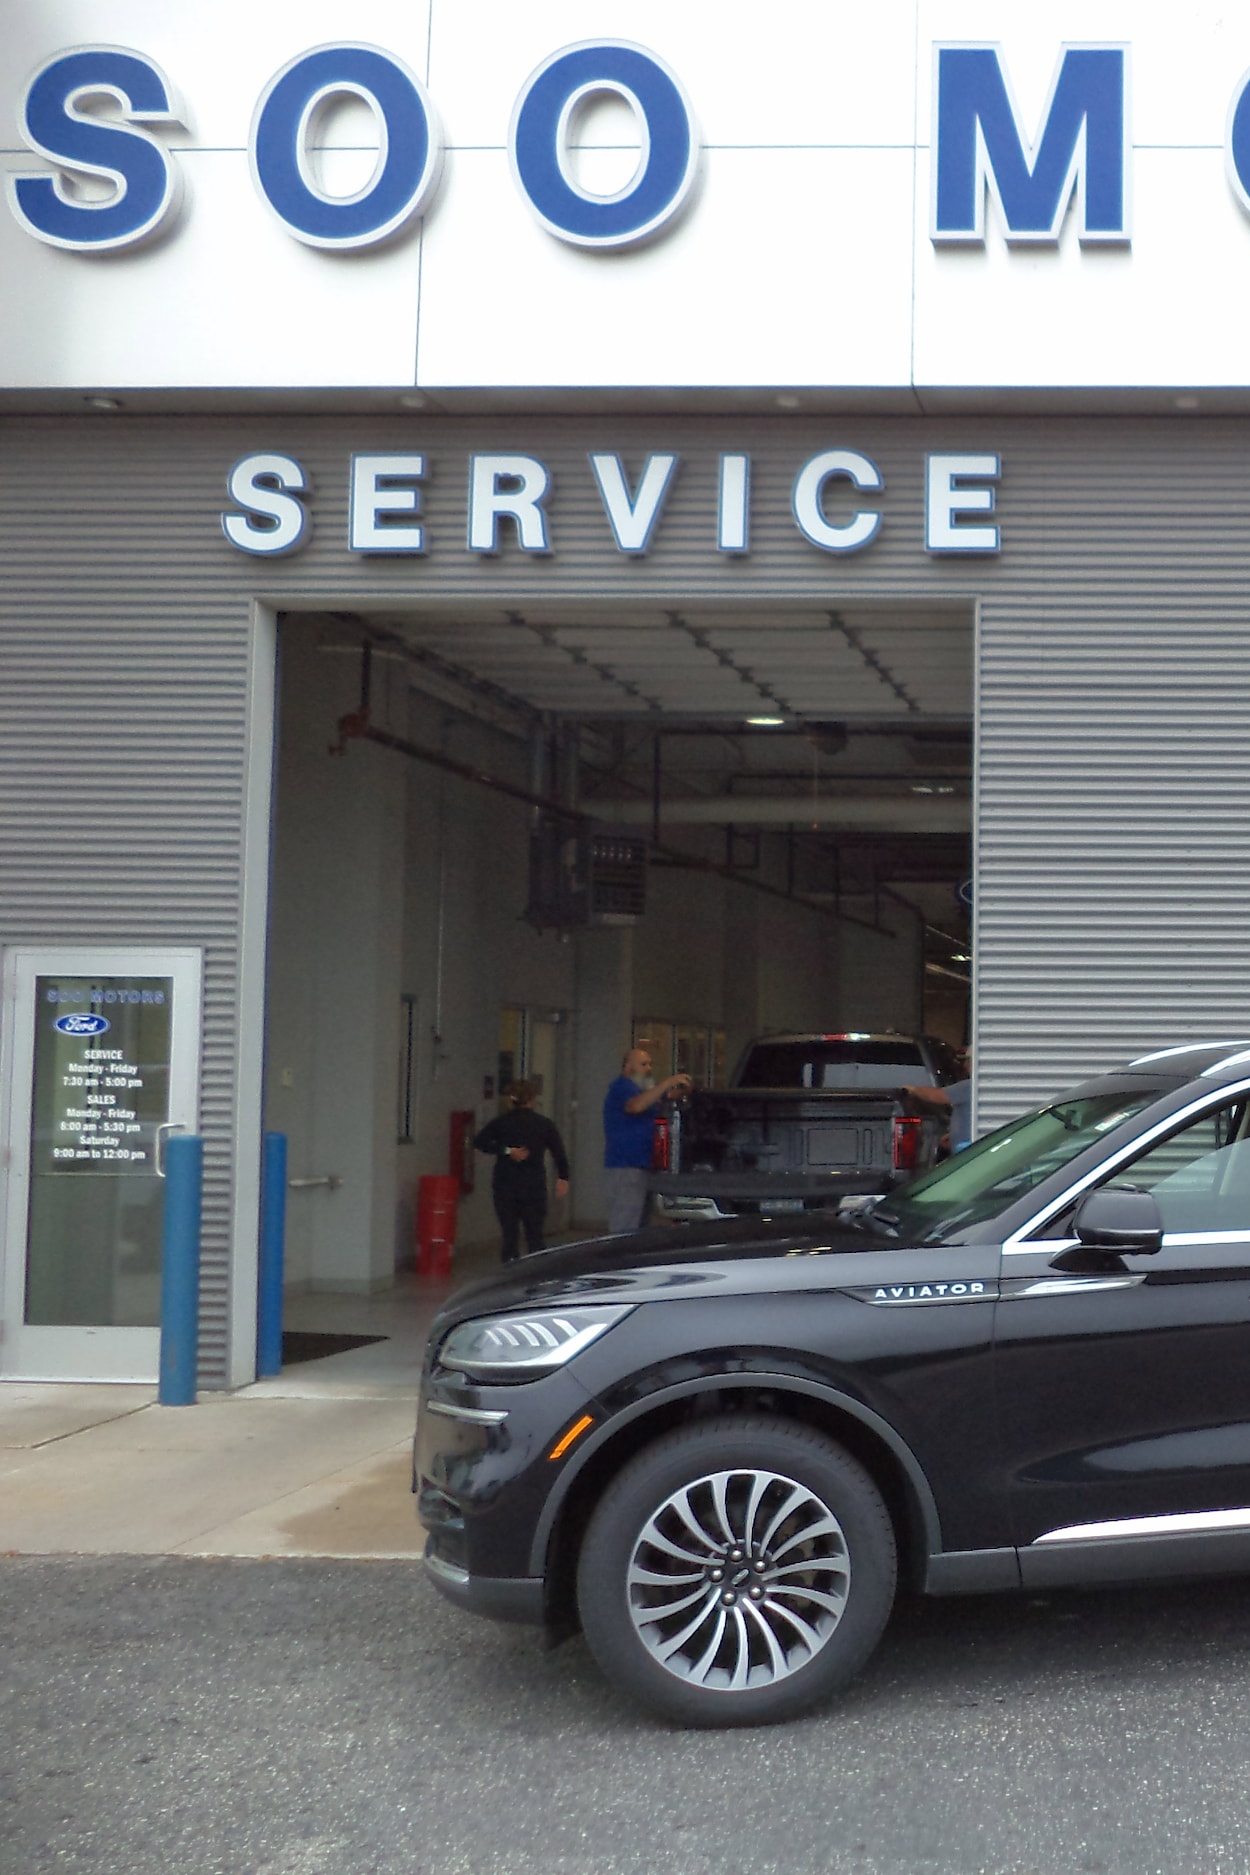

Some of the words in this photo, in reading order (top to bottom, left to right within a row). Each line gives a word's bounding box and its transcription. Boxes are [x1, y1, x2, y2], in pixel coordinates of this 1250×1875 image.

[10, 38, 705, 252] SOO
[220, 448, 1002, 557] SERVICE
[65, 1016, 99, 1032] Ford
[84, 1050, 123, 1060] SERVICE
[69, 1063, 104, 1074] Monday
[110, 1064, 138, 1075] Friday
[128, 1079, 143, 1088] pm
[87, 1095, 116, 1105] SALES
[66, 1108, 102, 1119] Monday
[108, 1109, 136, 1120] Friday
[126, 1125, 141, 1134] pm
[80, 1136, 120, 1148] Saturday
[92, 1150, 101, 1158] to
[131, 1152, 146, 1160] pm
[875, 1282, 984, 1297] AVIATOR
